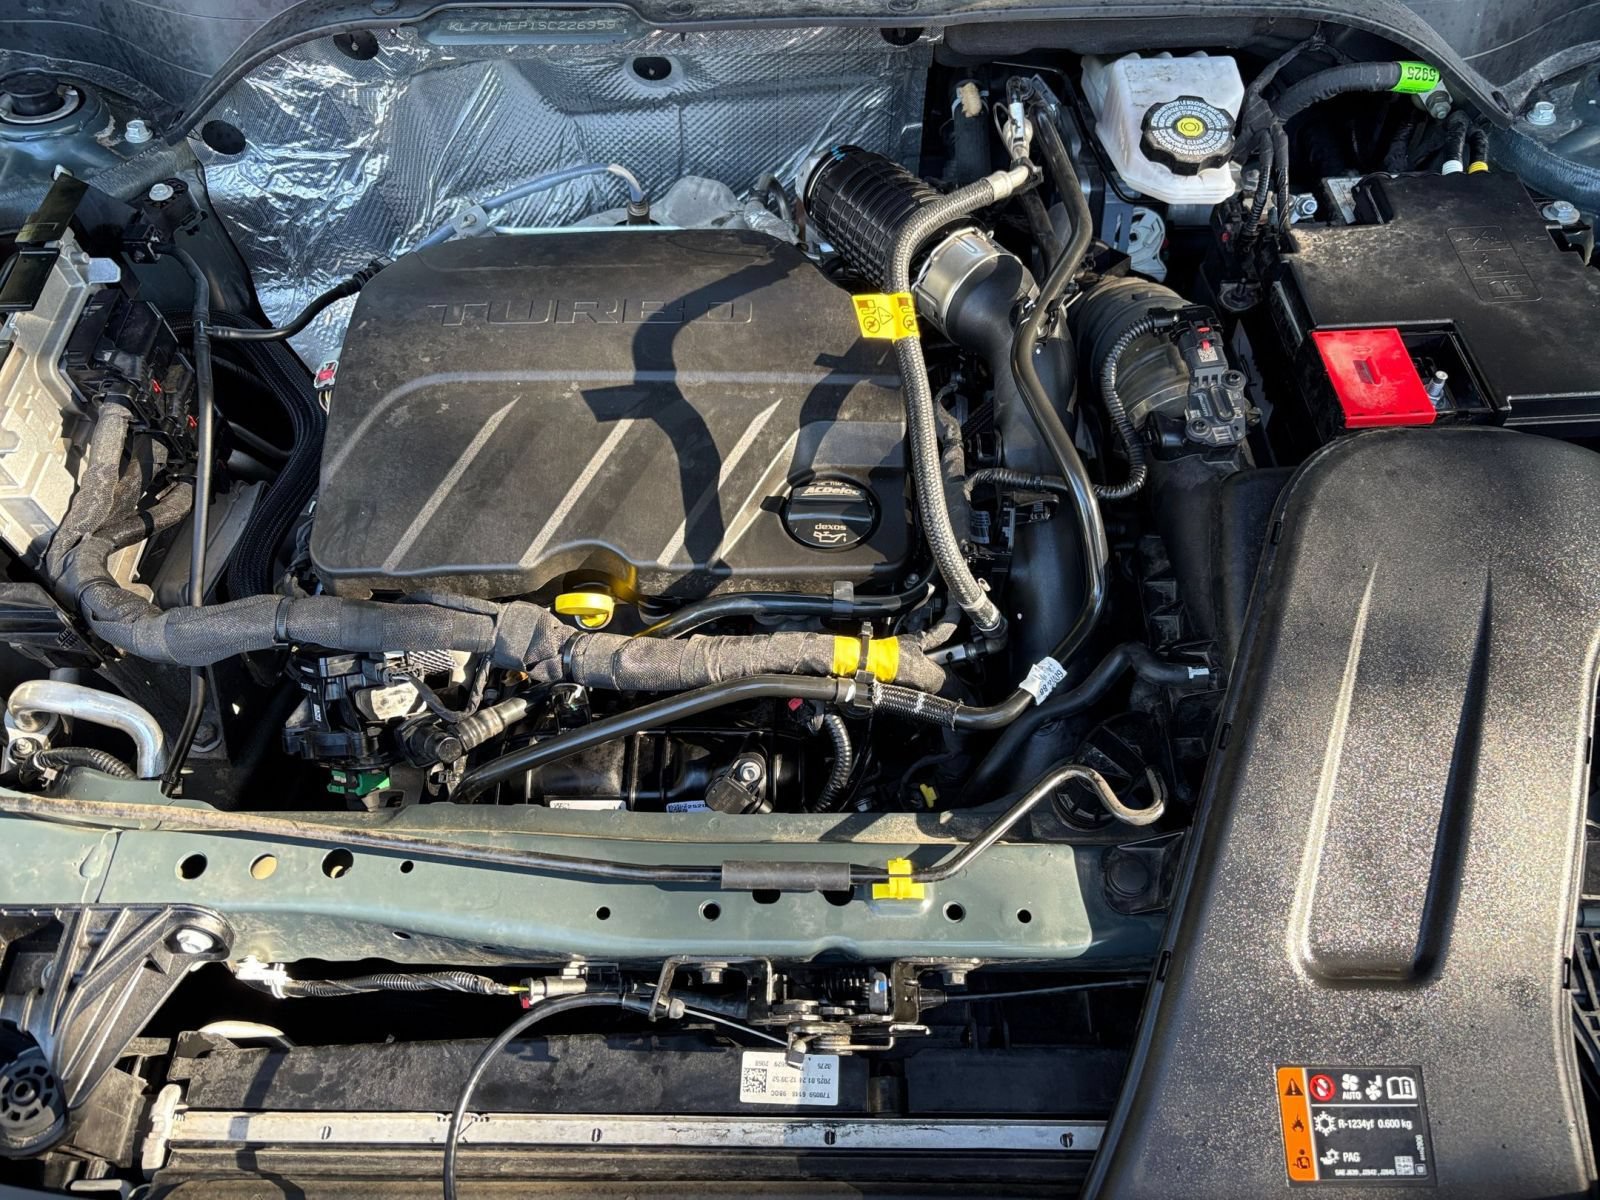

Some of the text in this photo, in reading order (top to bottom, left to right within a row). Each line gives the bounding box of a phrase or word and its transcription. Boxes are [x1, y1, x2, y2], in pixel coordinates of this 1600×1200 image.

[1407, 66, 1437, 82] 5925
[426, 298, 753, 327] TURBO
[803, 486, 861, 496] ACDelco
[814, 522, 847, 531] dexos
[1341, 1091, 1362, 1101] AUTO
[1338, 1118, 1413, 1131] R-1234yf 0.600 kg
[1342, 1151, 1361, 1163] PAG
